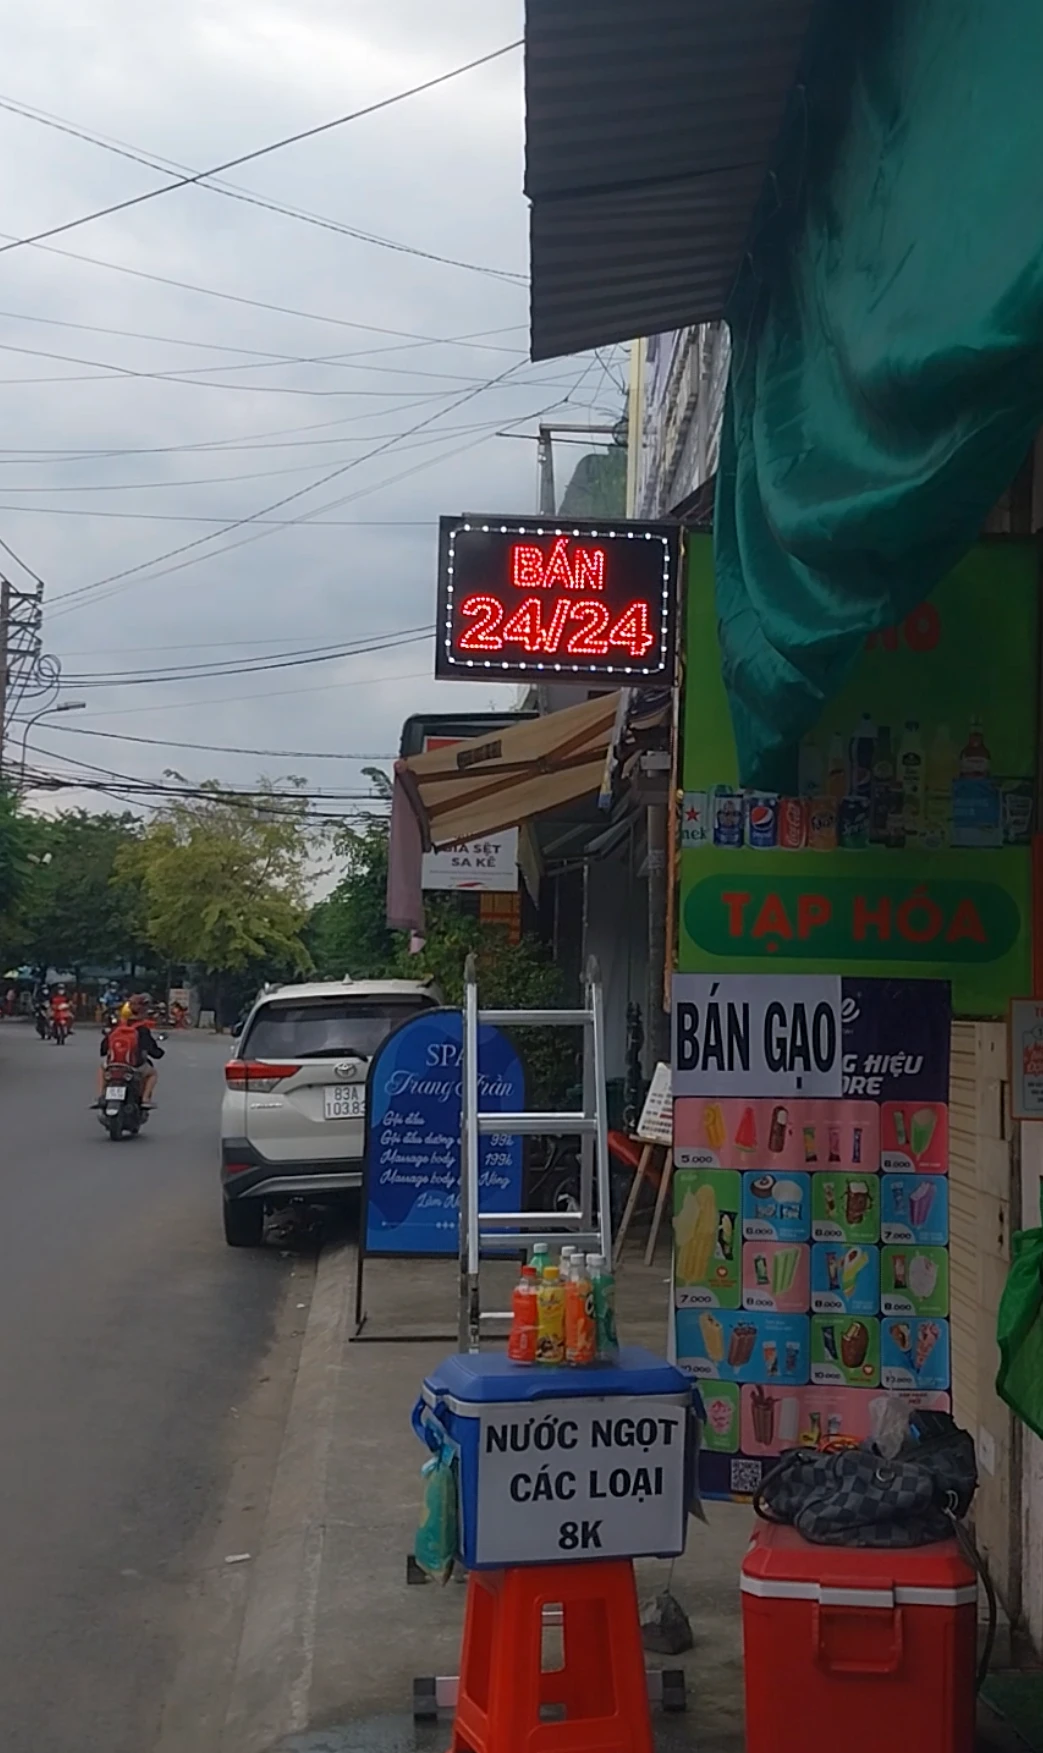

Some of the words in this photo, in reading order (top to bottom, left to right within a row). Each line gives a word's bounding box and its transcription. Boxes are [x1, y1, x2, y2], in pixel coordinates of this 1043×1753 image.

[513, 537, 605, 590] BÁN
[460, 597, 654, 656] 24/24
[452, 857, 472, 868] SA
[476, 856, 496, 868] KÊ
[721, 892, 832, 952] TẠP
[853, 884, 988, 943] HÓA
[676, 982, 750, 1072] BÁN
[764, 1001, 836, 1089] GẠO
[863, 1050, 924, 1078] HIỆU
[335, 1087, 359, 1101] 83A
[380, 1148, 429, 1168] Massage
[430, 1150, 456, 1169] body
[681, 1154, 712, 1163] 5.000
[380, 1168, 429, 1188] Massage
[430, 1171, 456, 1189] body
[680, 1294, 712, 1304] 7.000
[486, 1415, 578, 1453] NƯỚC
[591, 1418, 679, 1453] NGỌT
[510, 1464, 576, 1502] CÁC
[589, 1467, 663, 1503] LOẠI
[558, 1520, 604, 1550] 8K
